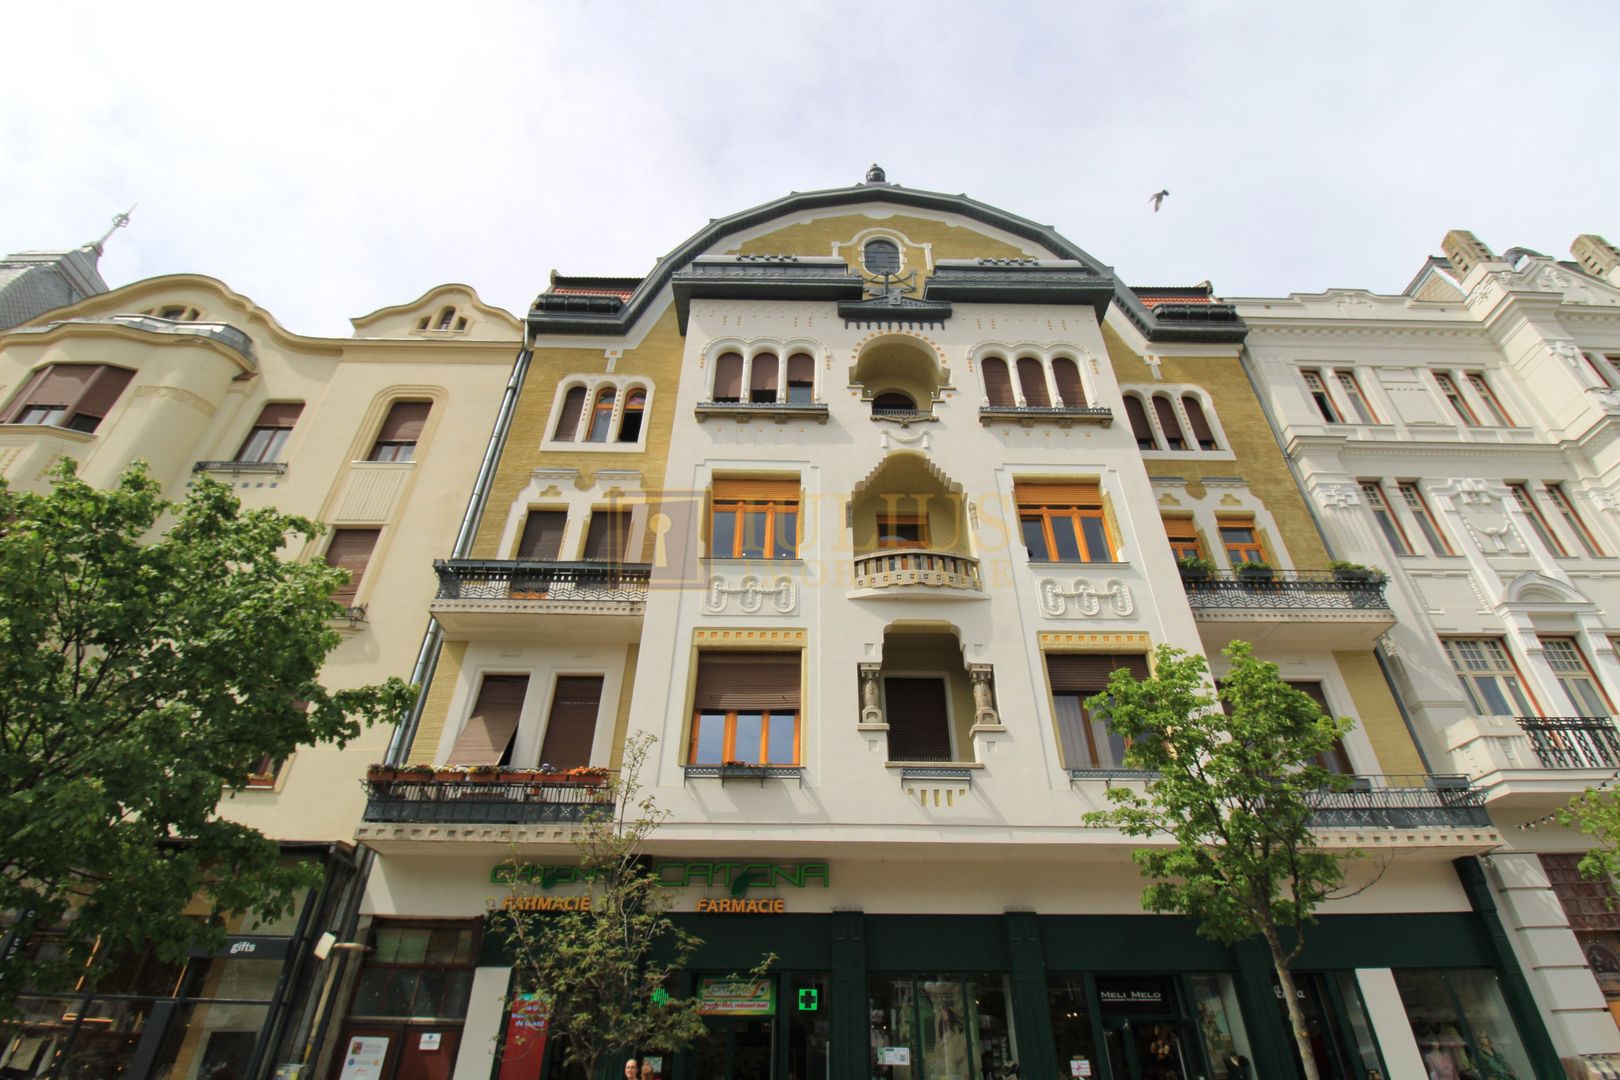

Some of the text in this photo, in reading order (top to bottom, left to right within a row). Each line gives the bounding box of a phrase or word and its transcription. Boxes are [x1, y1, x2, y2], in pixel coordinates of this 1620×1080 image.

[656, 862, 830, 889] CATENA
[502, 896, 592, 911] FARMACIE
[696, 898, 785, 913] FARMACIE
[230, 941, 256, 954] gifts
